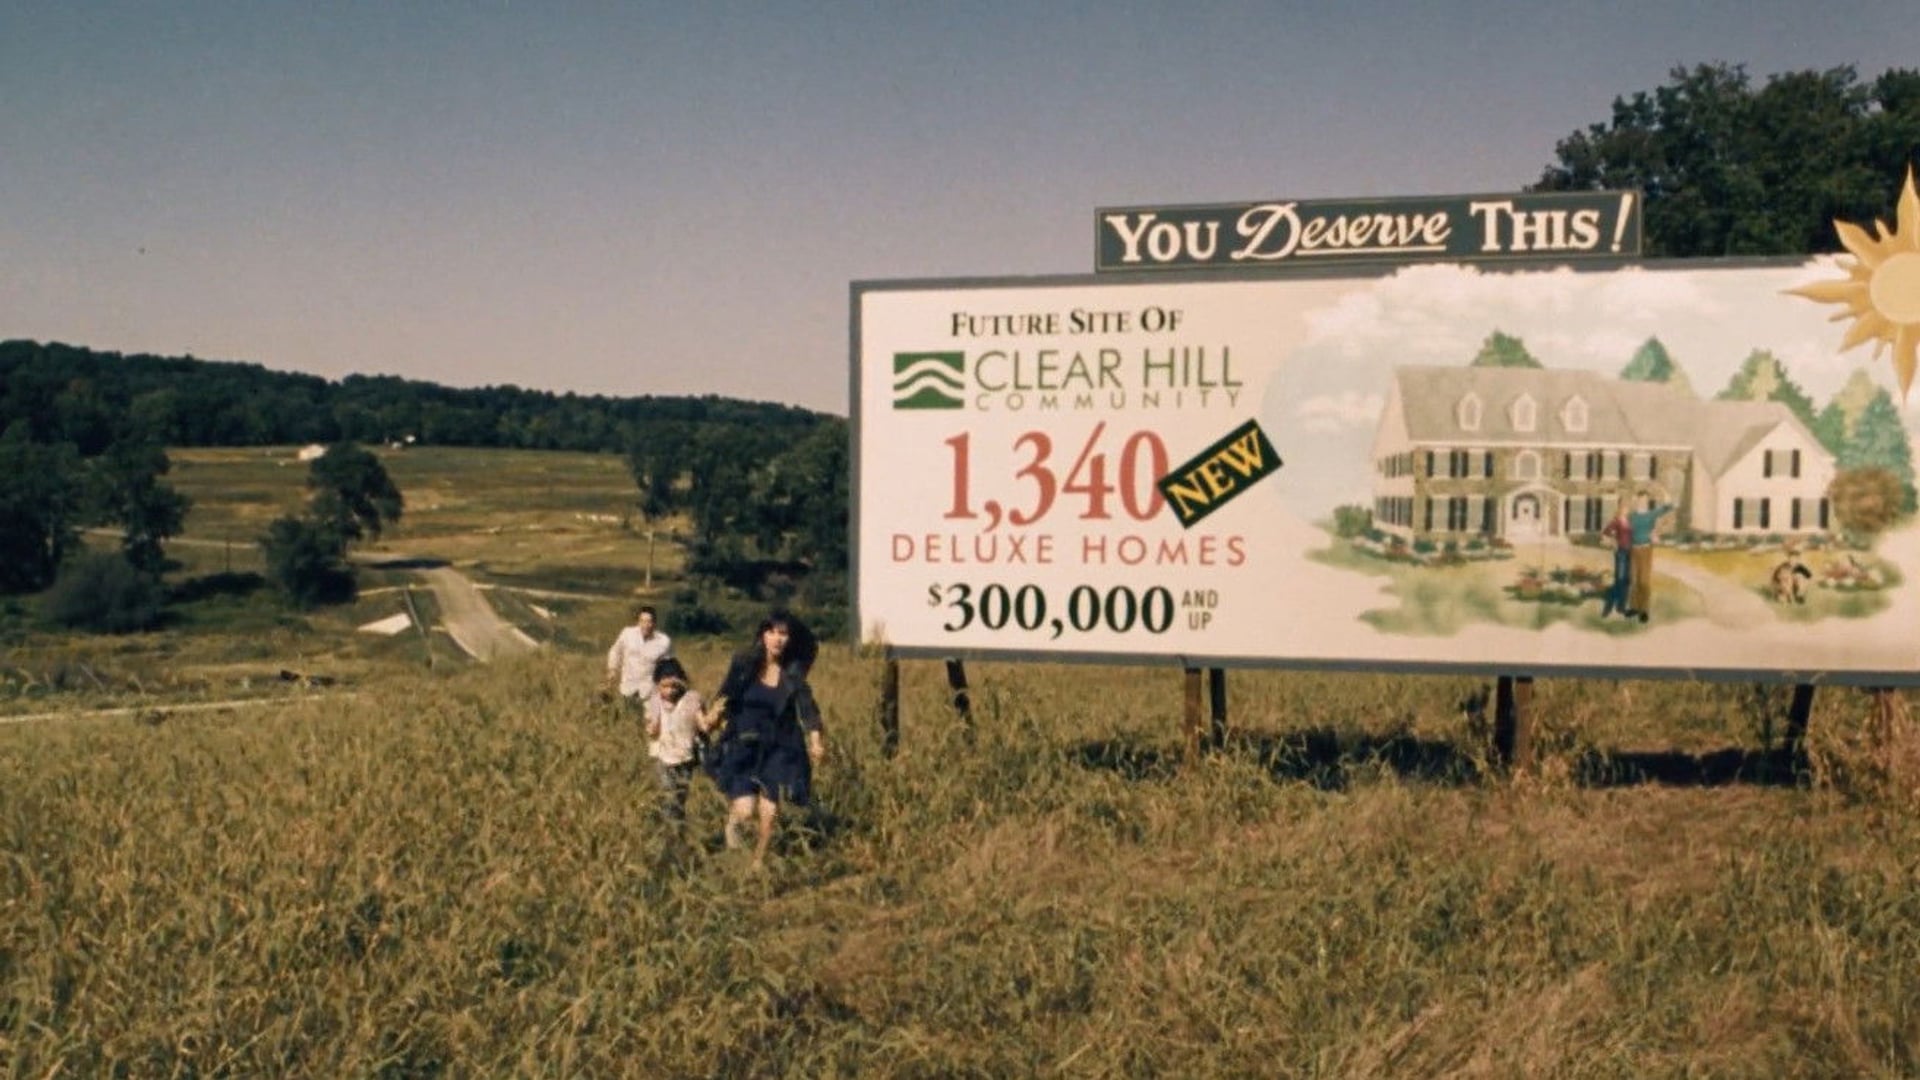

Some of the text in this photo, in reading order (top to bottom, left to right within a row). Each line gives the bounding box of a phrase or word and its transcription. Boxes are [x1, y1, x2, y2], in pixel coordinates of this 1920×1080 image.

[1105, 212, 1220, 263] YOU
[1230, 202, 1452, 261] Deserve
[951, 306, 1184, 337] FUTURE SITE OF
[974, 346, 1243, 392] CLEAR HILL
[975, 388, 1243, 411] COMMUNITY
[943, 421, 1169, 533] 1,340
[1167, 427, 1268, 519] NEW
[891, 533, 1247, 567] DELUXE HOMES
[928, 582, 1175, 640] $300,000
[1181, 589, 1218, 609] AND
[1189, 611, 1212, 631] UP
